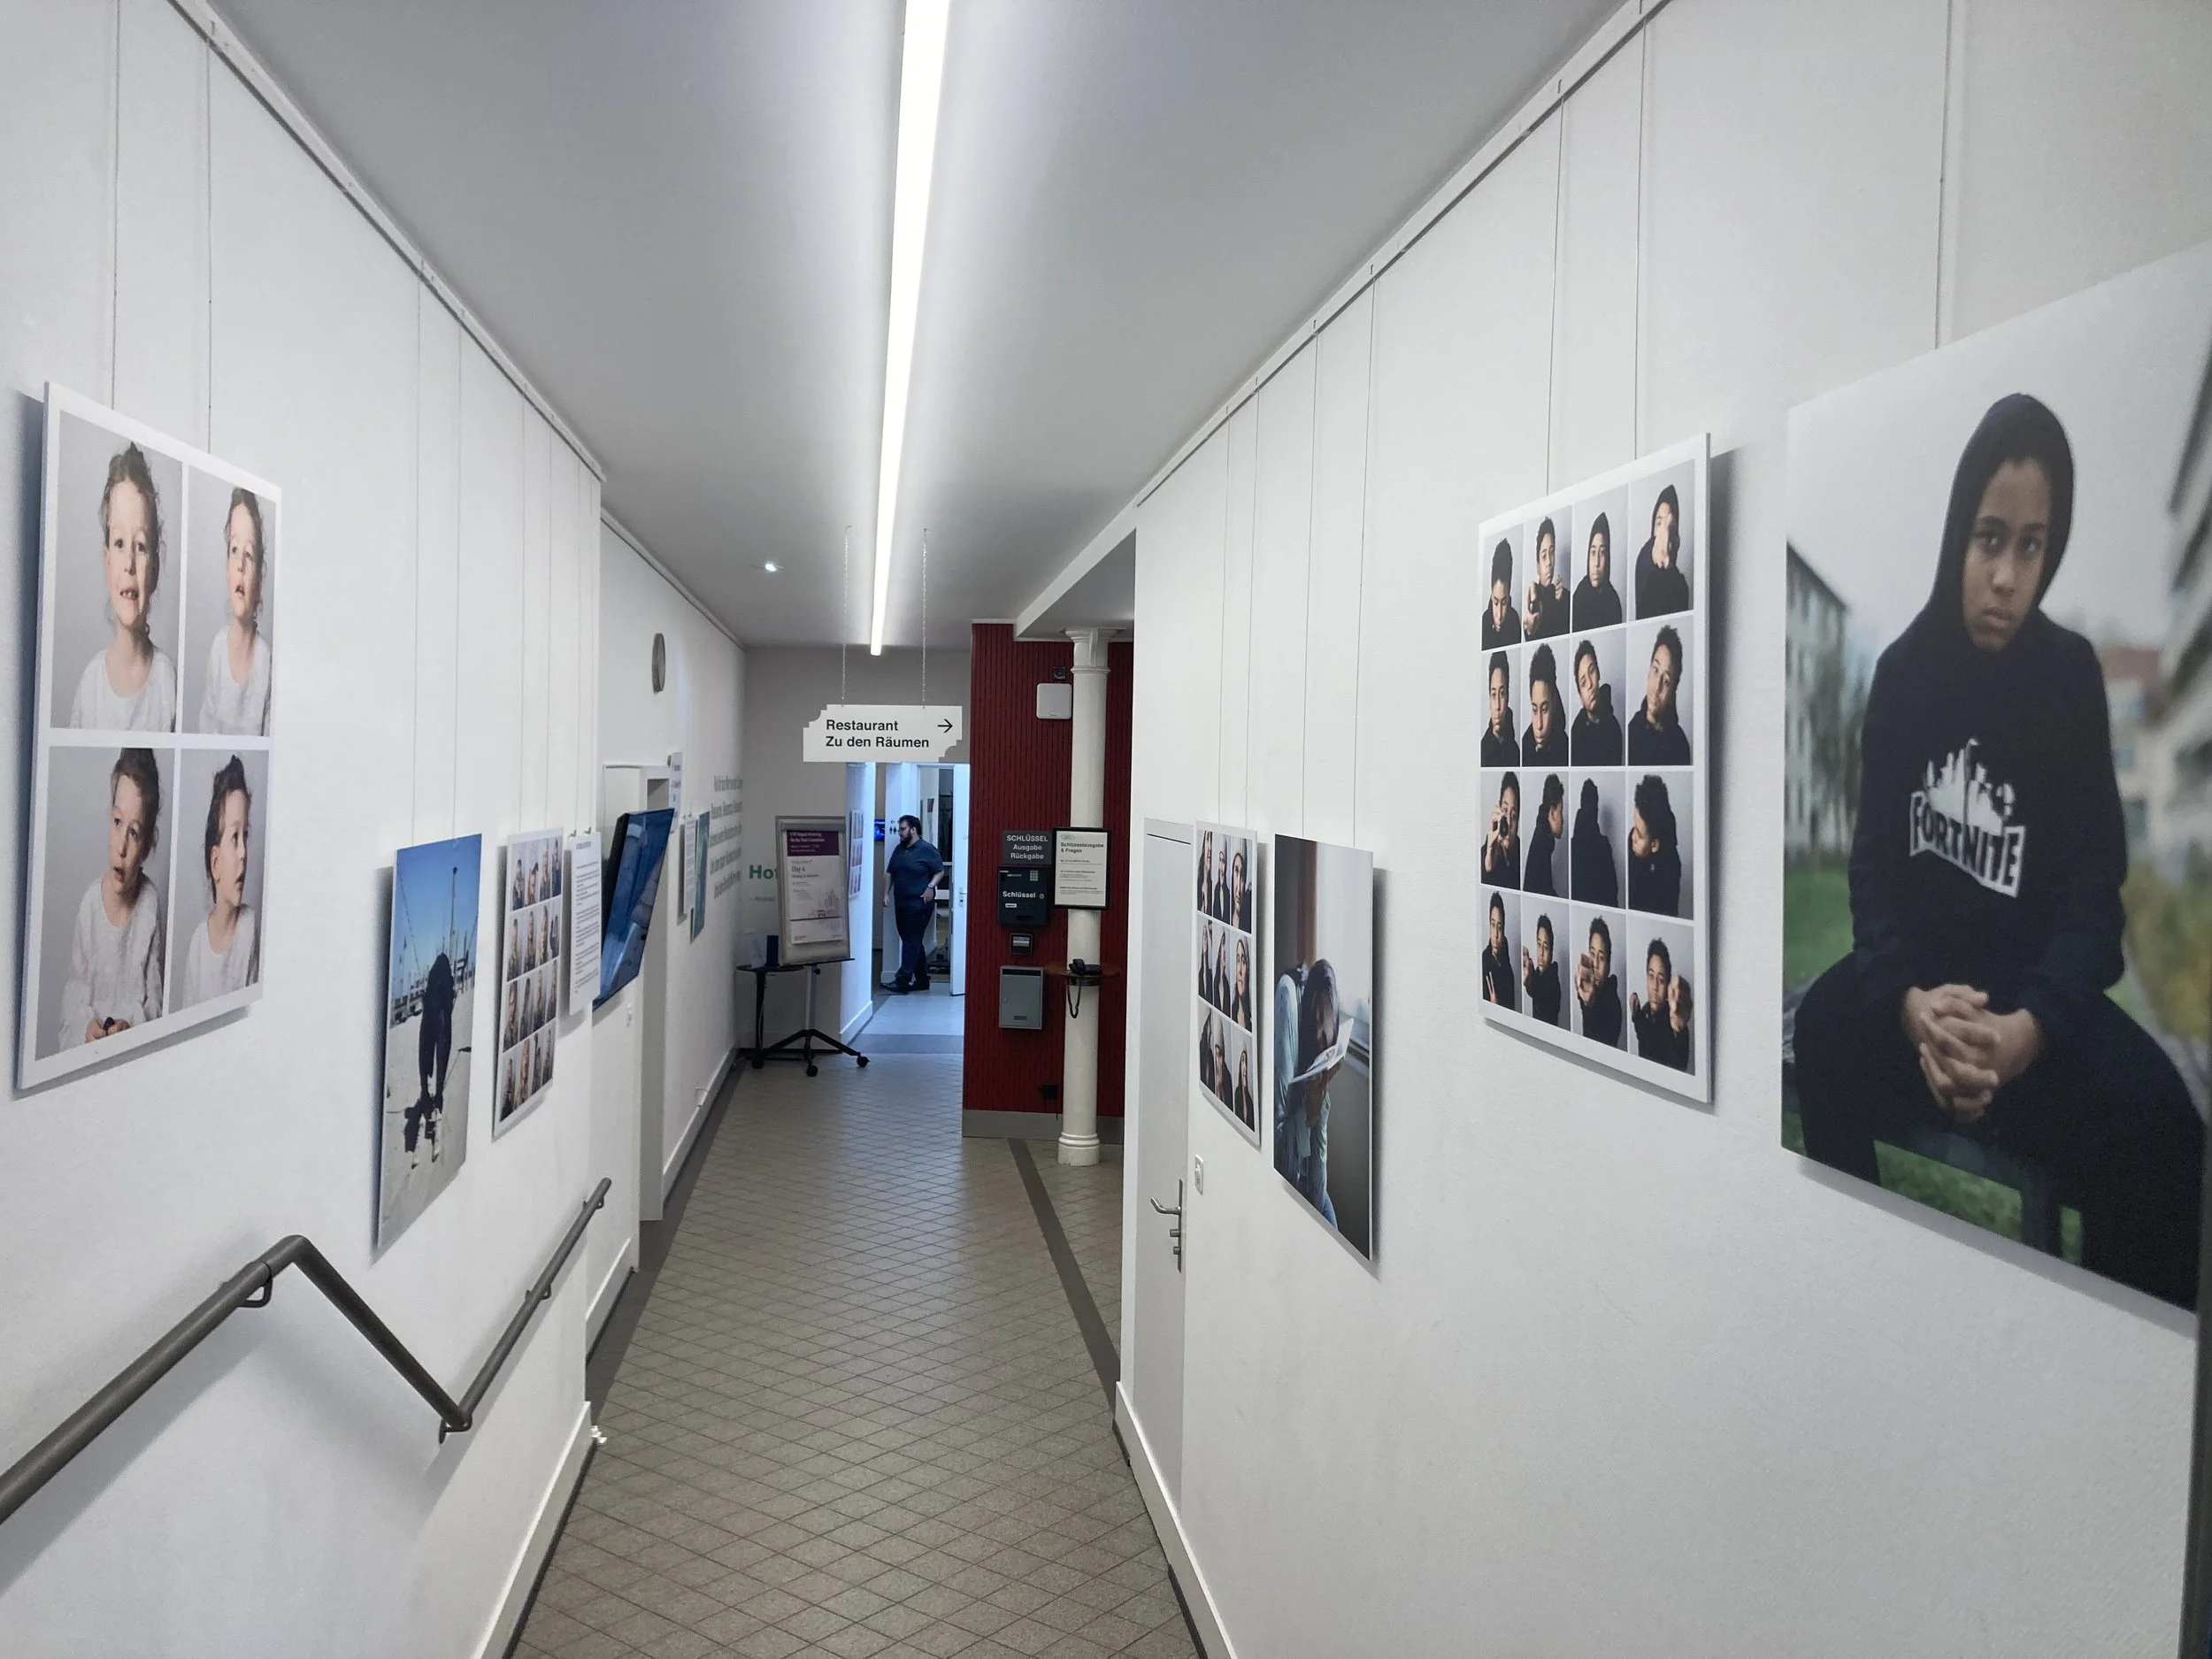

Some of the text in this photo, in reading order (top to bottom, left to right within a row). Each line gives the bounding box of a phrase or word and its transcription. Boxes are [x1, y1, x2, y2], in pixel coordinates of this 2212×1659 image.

[826, 719, 899, 731] Restaurant
[826, 736, 930, 748] Zu den Räumen
[1909, 790, 2025, 896] FORTNITE
